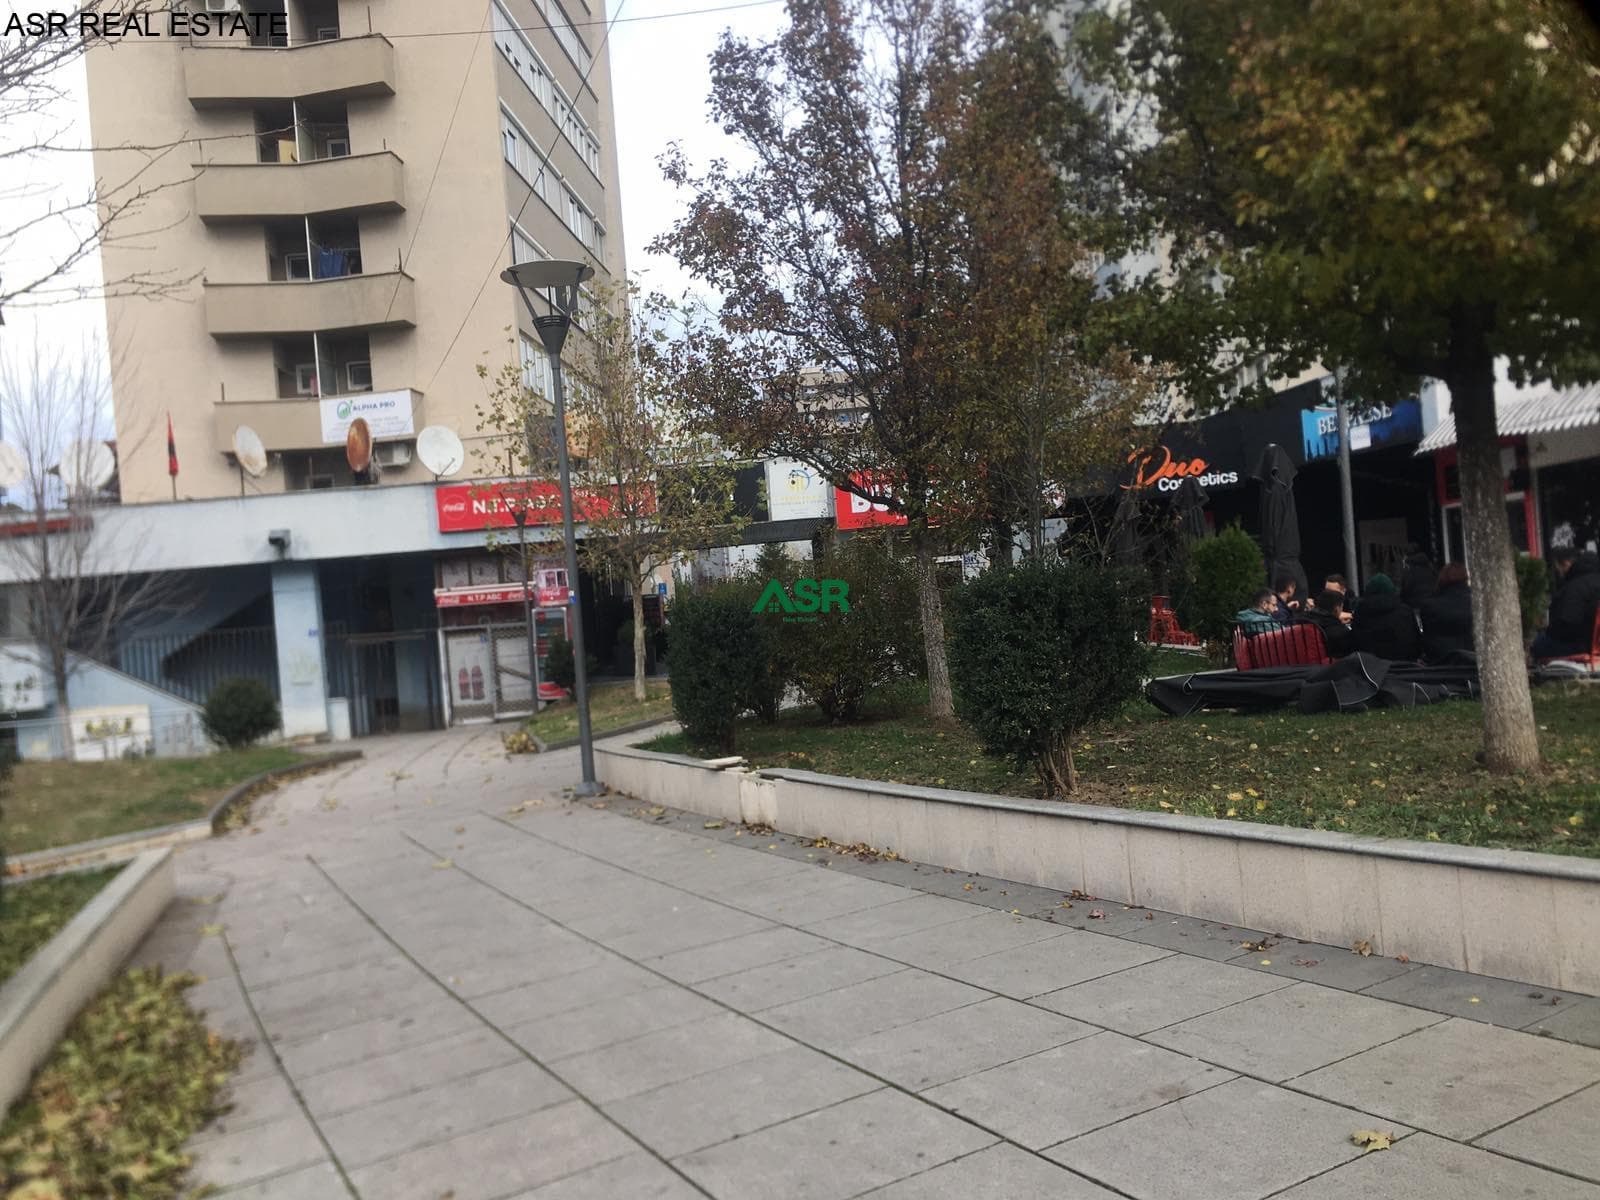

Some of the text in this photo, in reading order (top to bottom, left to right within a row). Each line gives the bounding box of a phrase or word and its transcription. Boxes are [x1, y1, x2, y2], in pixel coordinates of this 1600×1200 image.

[352, 402, 378, 411] ALPHA
[1120, 445, 1210, 489] Duo
[1157, 470, 1239, 492] Cosetics
